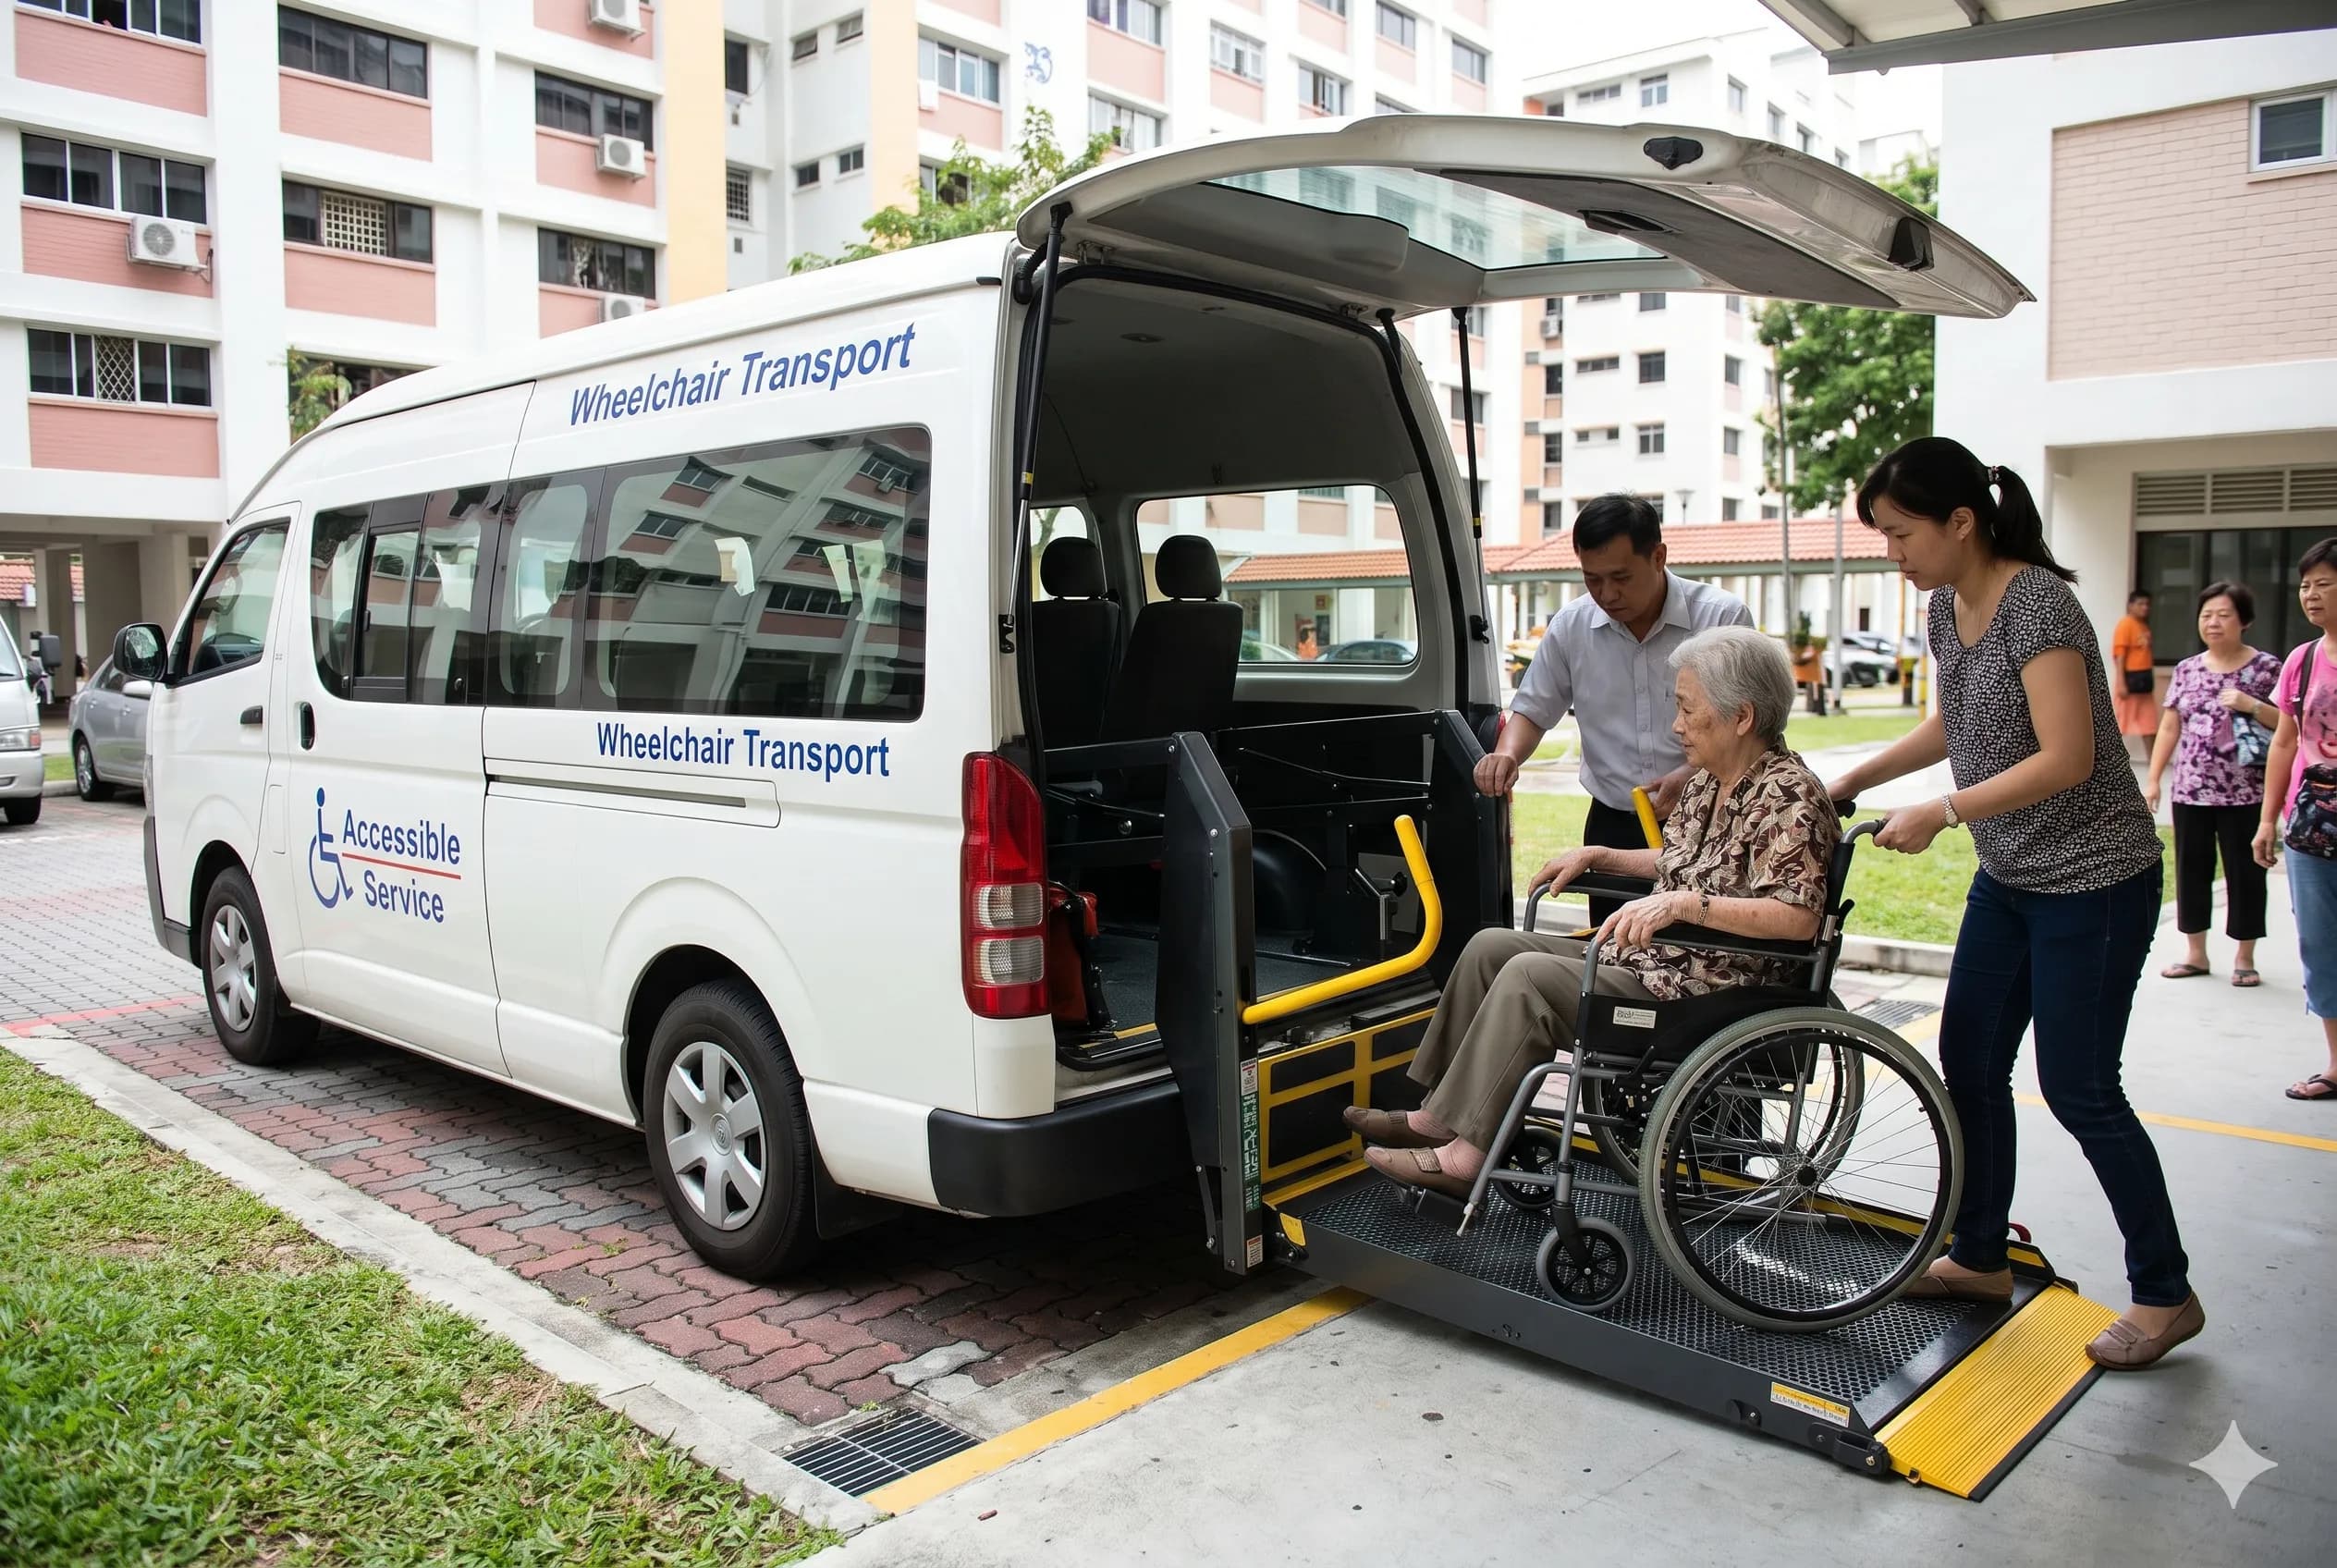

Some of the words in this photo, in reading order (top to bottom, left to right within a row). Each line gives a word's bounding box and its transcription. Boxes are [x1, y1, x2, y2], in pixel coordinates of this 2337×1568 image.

[570, 361, 730, 425] Wheelchair
[742, 323, 915, 395] Transport
[597, 722, 734, 764] Wheelchair
[742, 729, 889, 782] Transport
[343, 809, 460, 864] Accessible
[364, 870, 444, 923] Service
